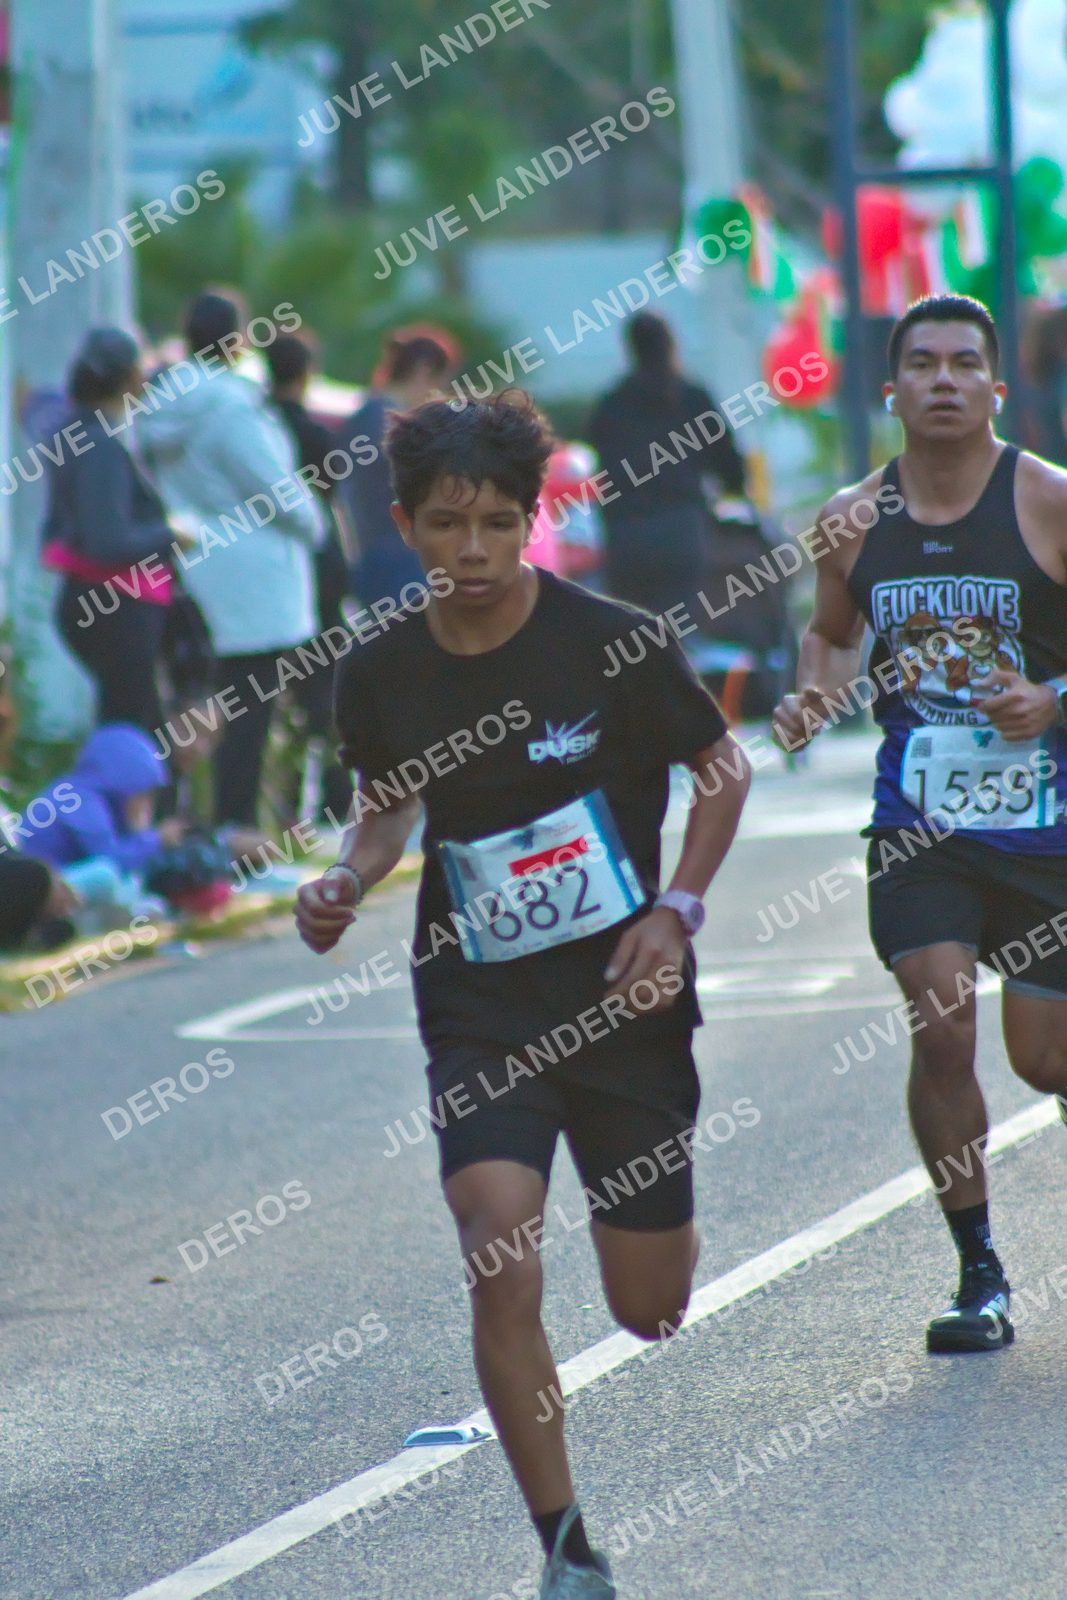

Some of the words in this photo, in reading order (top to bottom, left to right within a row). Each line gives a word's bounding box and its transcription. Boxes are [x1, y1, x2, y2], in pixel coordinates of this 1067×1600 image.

[875, 580, 1019, 635] FUCKLOVE
[527, 730, 600, 762] DUSK
[913, 769, 1034, 815] 1555
[488, 865, 601, 942] 682
